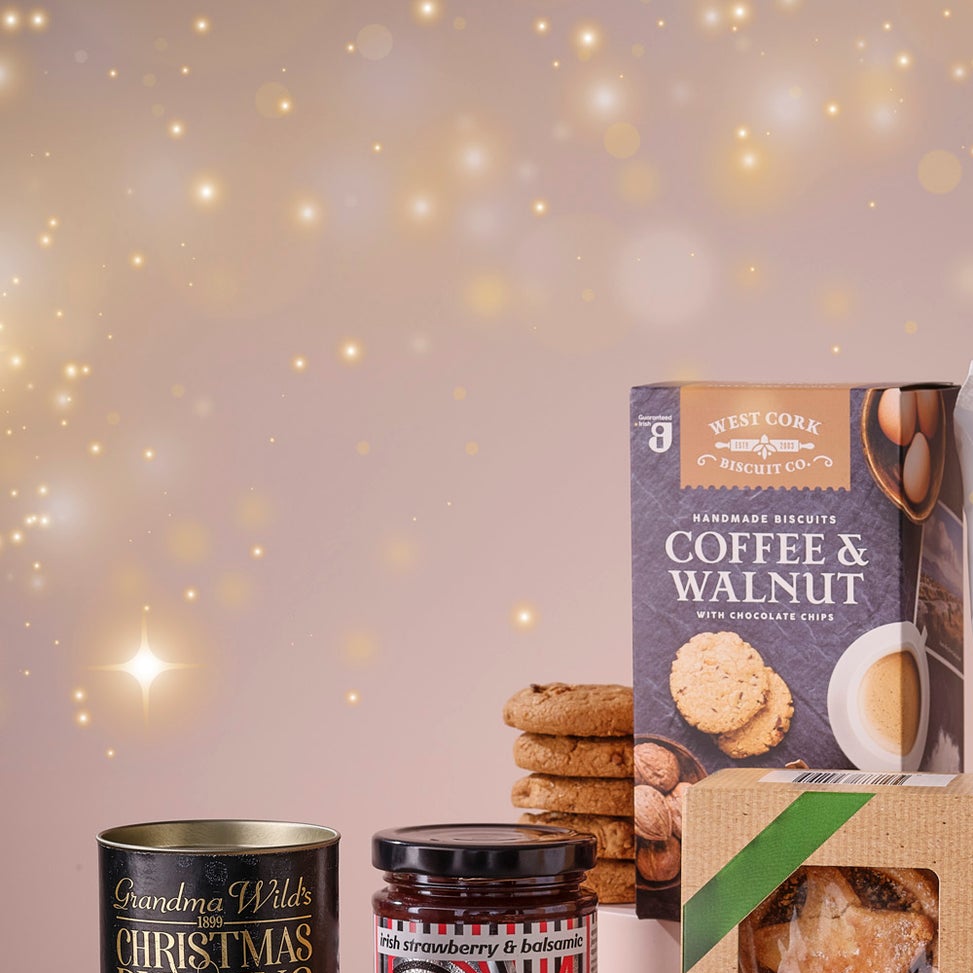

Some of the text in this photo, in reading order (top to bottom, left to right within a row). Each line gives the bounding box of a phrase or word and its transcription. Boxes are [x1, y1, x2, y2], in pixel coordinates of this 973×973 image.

[708, 411, 822, 435] WEST CORK
[720, 457, 782, 475] BISCUIT
[693, 513, 837, 524] HANDMADE BISCUITS
[665, 530, 869, 566] COFFEE &
[668, 570, 865, 605] WALNUT
[696, 611, 835, 621] WITH CHOCOLATE CHIPS
[113, 876, 312, 914] Grandma Wild's
[197, 916, 223, 929] 1899
[116, 923, 313, 970] CHRISTMAS
[380, 932, 584, 958] irish strawberry & balsamic
